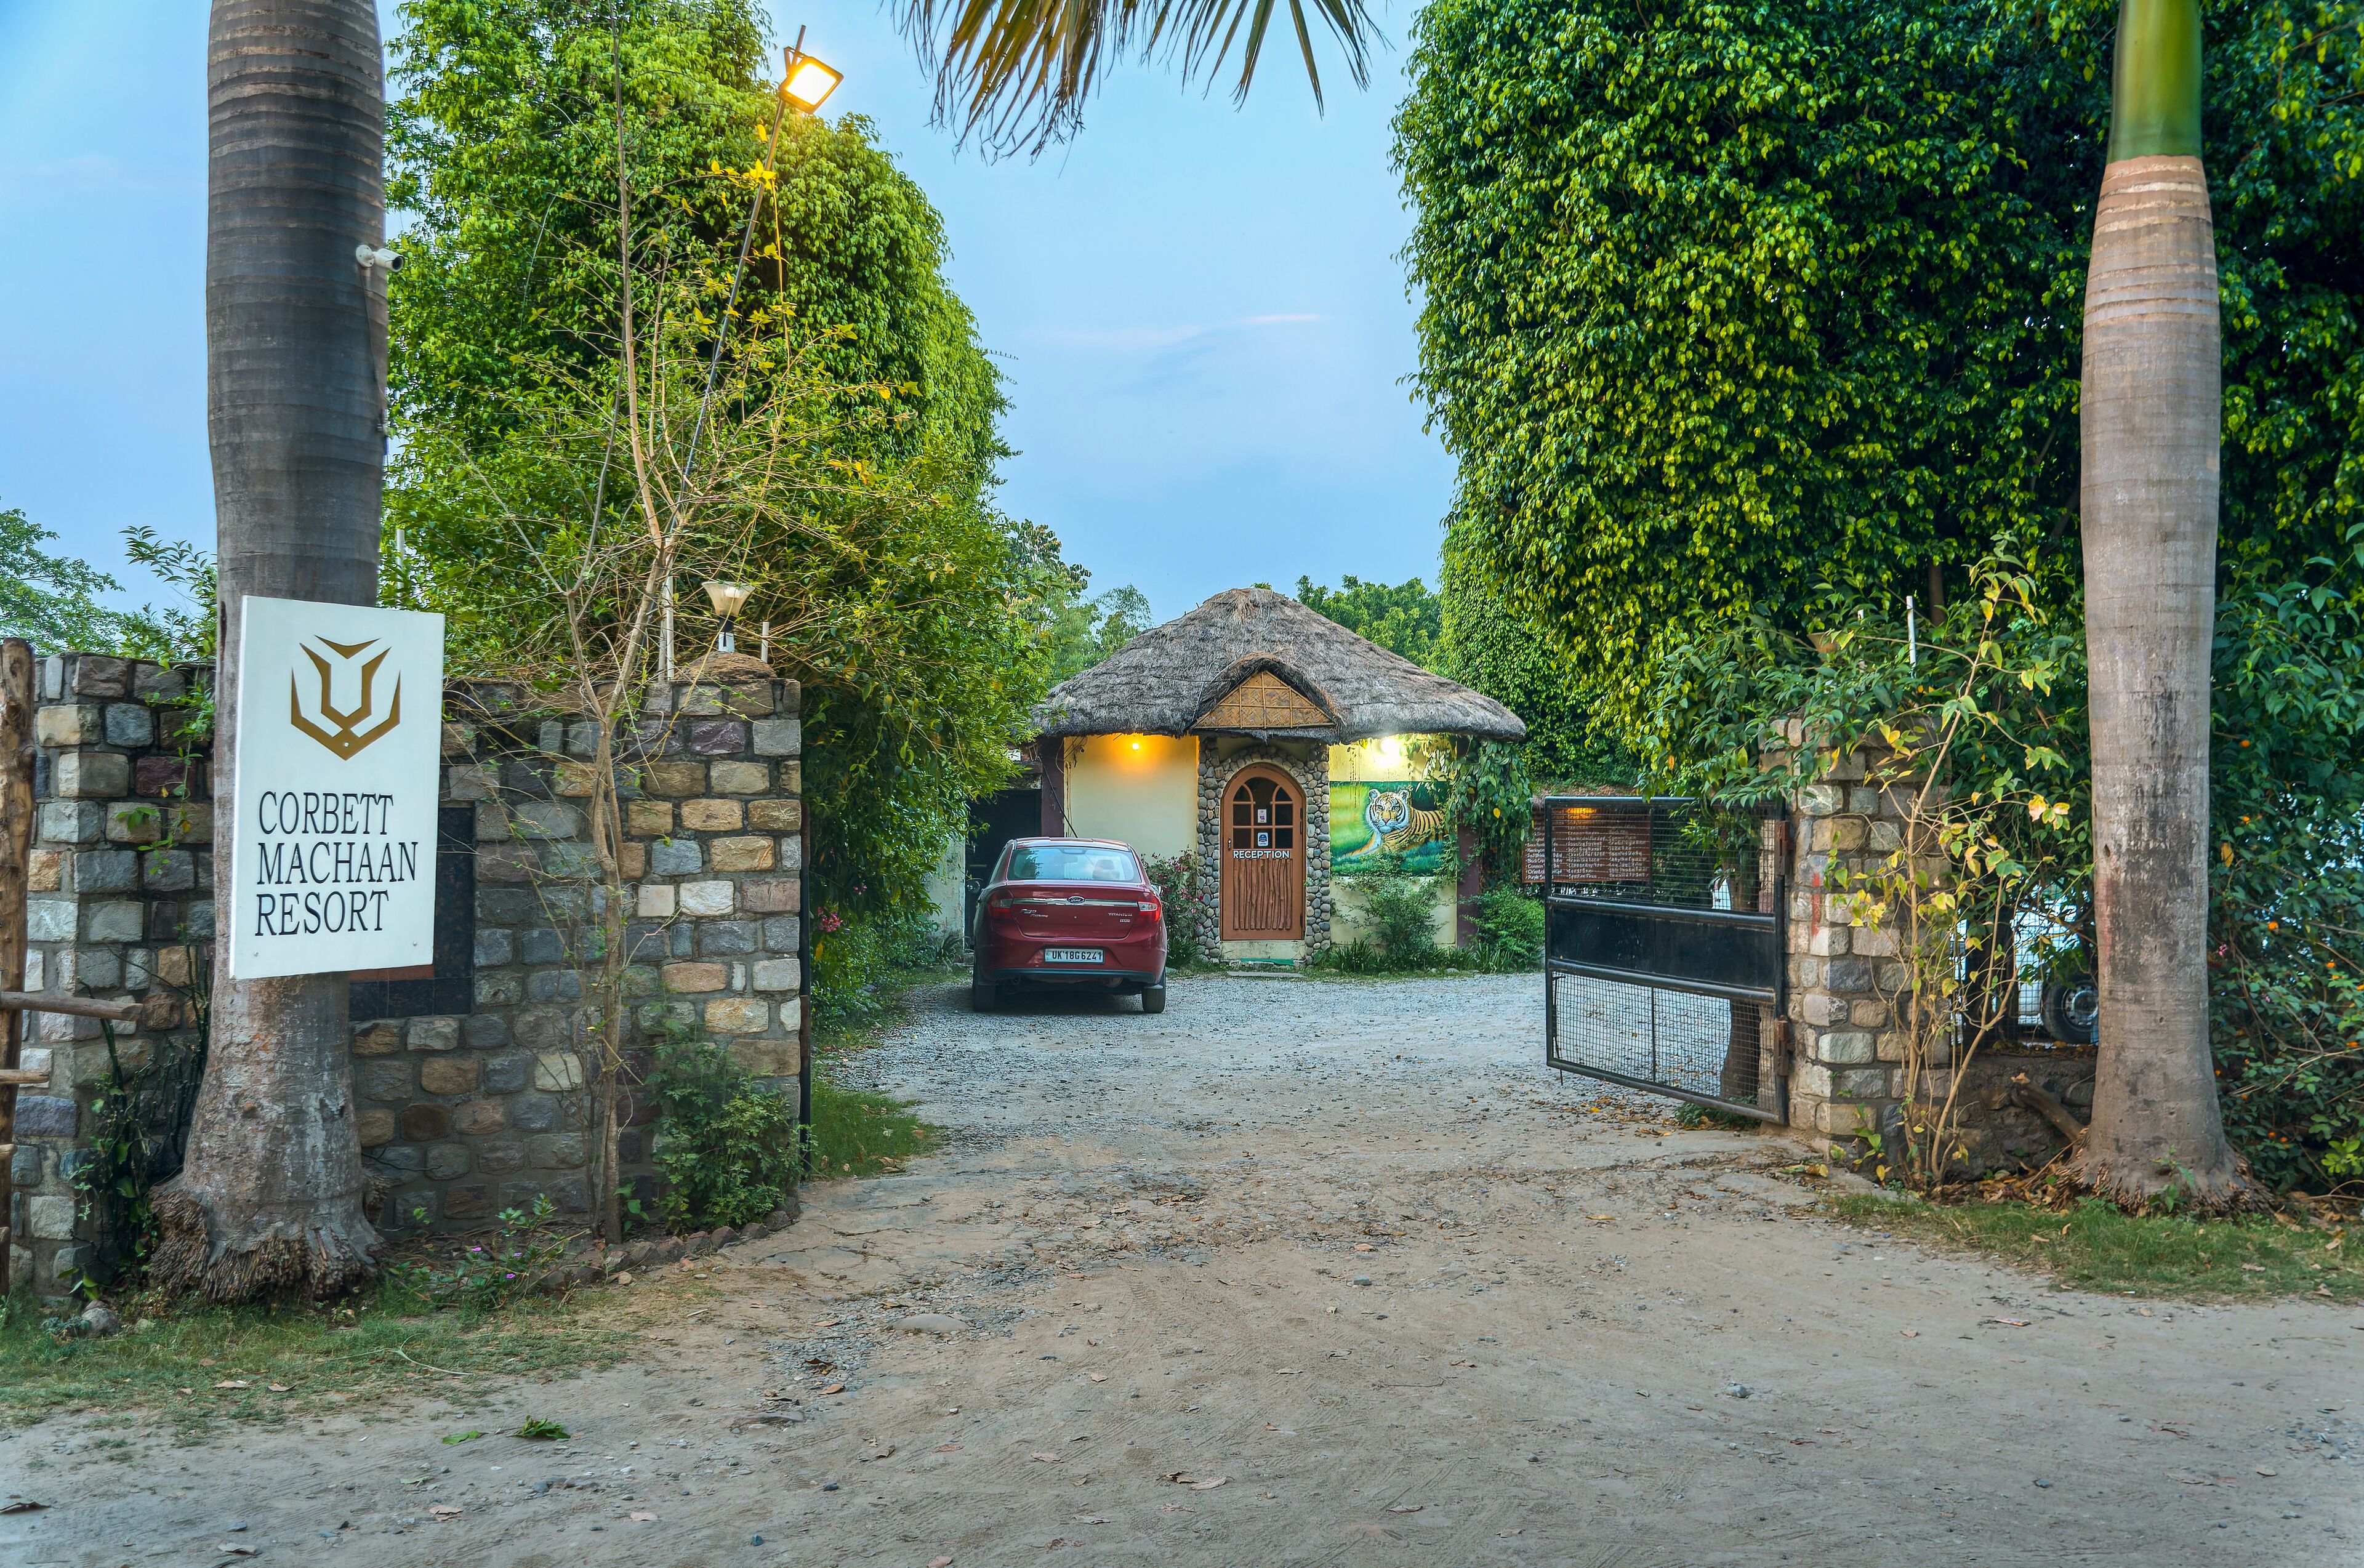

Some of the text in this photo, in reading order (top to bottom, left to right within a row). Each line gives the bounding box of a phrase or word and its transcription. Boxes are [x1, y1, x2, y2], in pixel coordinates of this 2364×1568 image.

[259, 791, 394, 835] CORBETT
[257, 842, 419, 885] MACHAAN
[1232, 850, 1290, 859] RECEPTION
[254, 890, 390, 936] RESORT
